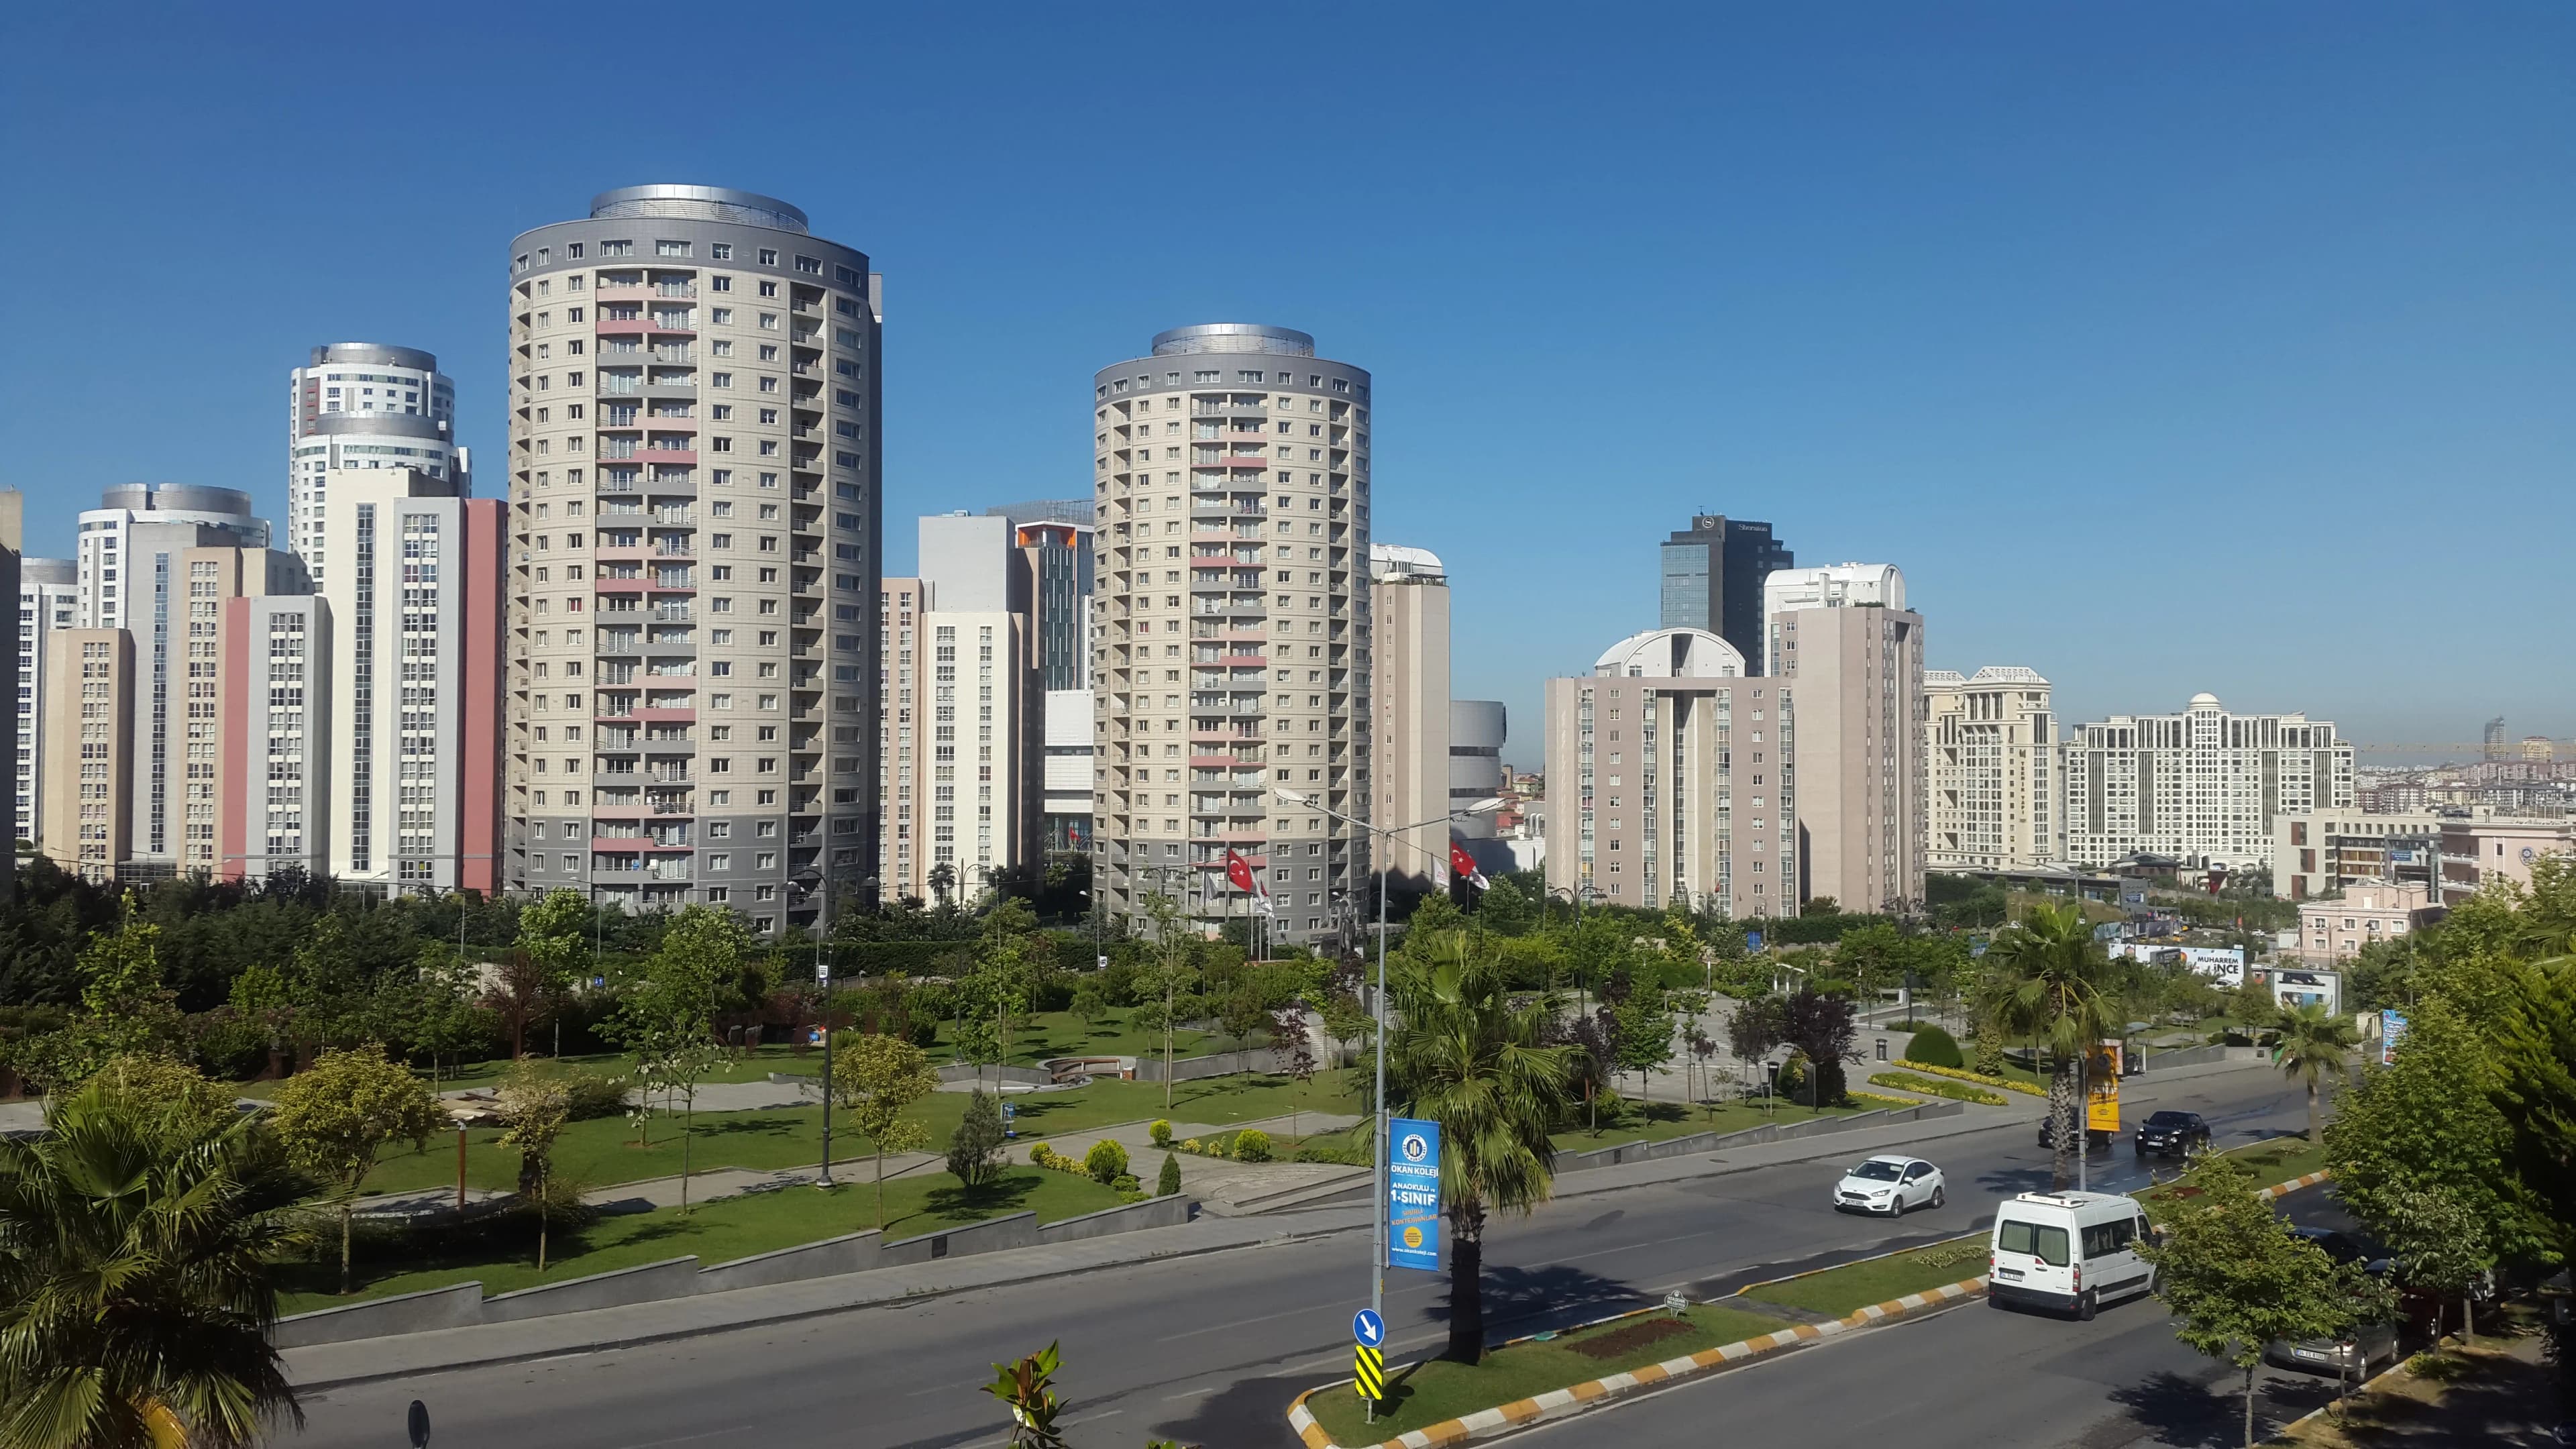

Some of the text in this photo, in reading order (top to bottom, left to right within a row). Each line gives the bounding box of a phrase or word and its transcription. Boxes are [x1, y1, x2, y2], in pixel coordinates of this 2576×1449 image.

[1738, 524, 1768, 532] Sheraton
[2198, 956, 2239, 964] MUHARREM
[1391, 1165, 1413, 1174] OKAN
[1393, 1182, 1429, 1191] ANAOKULU
